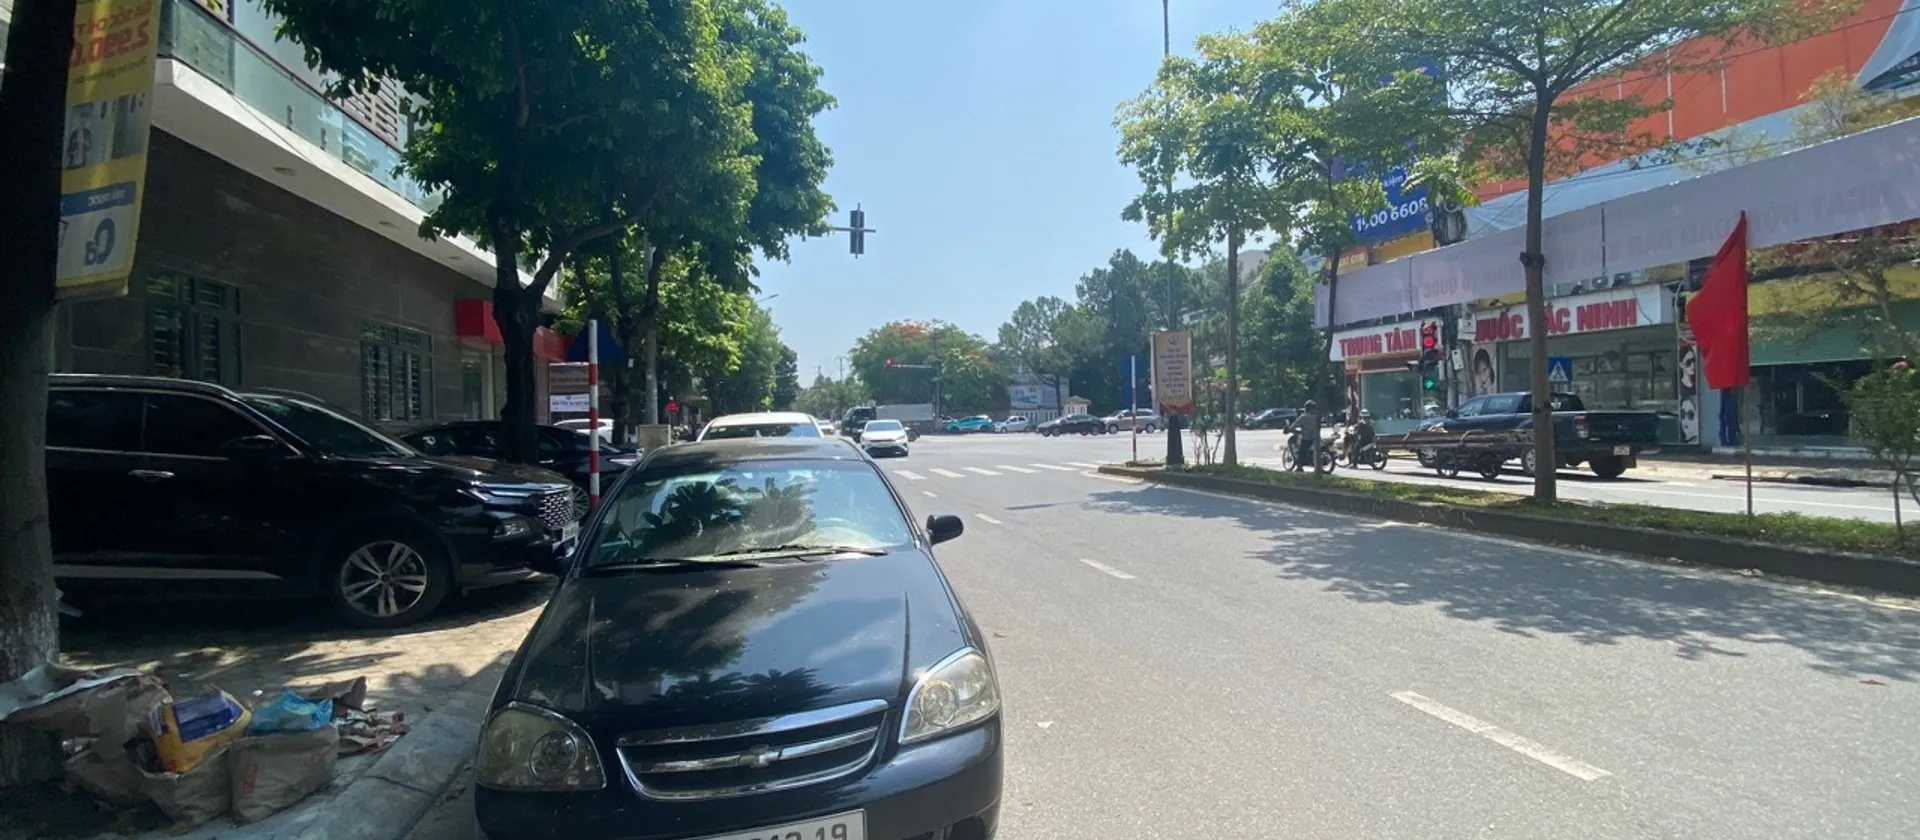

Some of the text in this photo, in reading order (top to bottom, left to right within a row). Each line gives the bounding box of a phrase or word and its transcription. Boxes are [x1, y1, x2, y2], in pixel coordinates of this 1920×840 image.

[1543, 302, 1571, 334] ẮC
[1576, 298, 1638, 331] NINH
[1338, 327, 1417, 357] TRUNG TÂM
